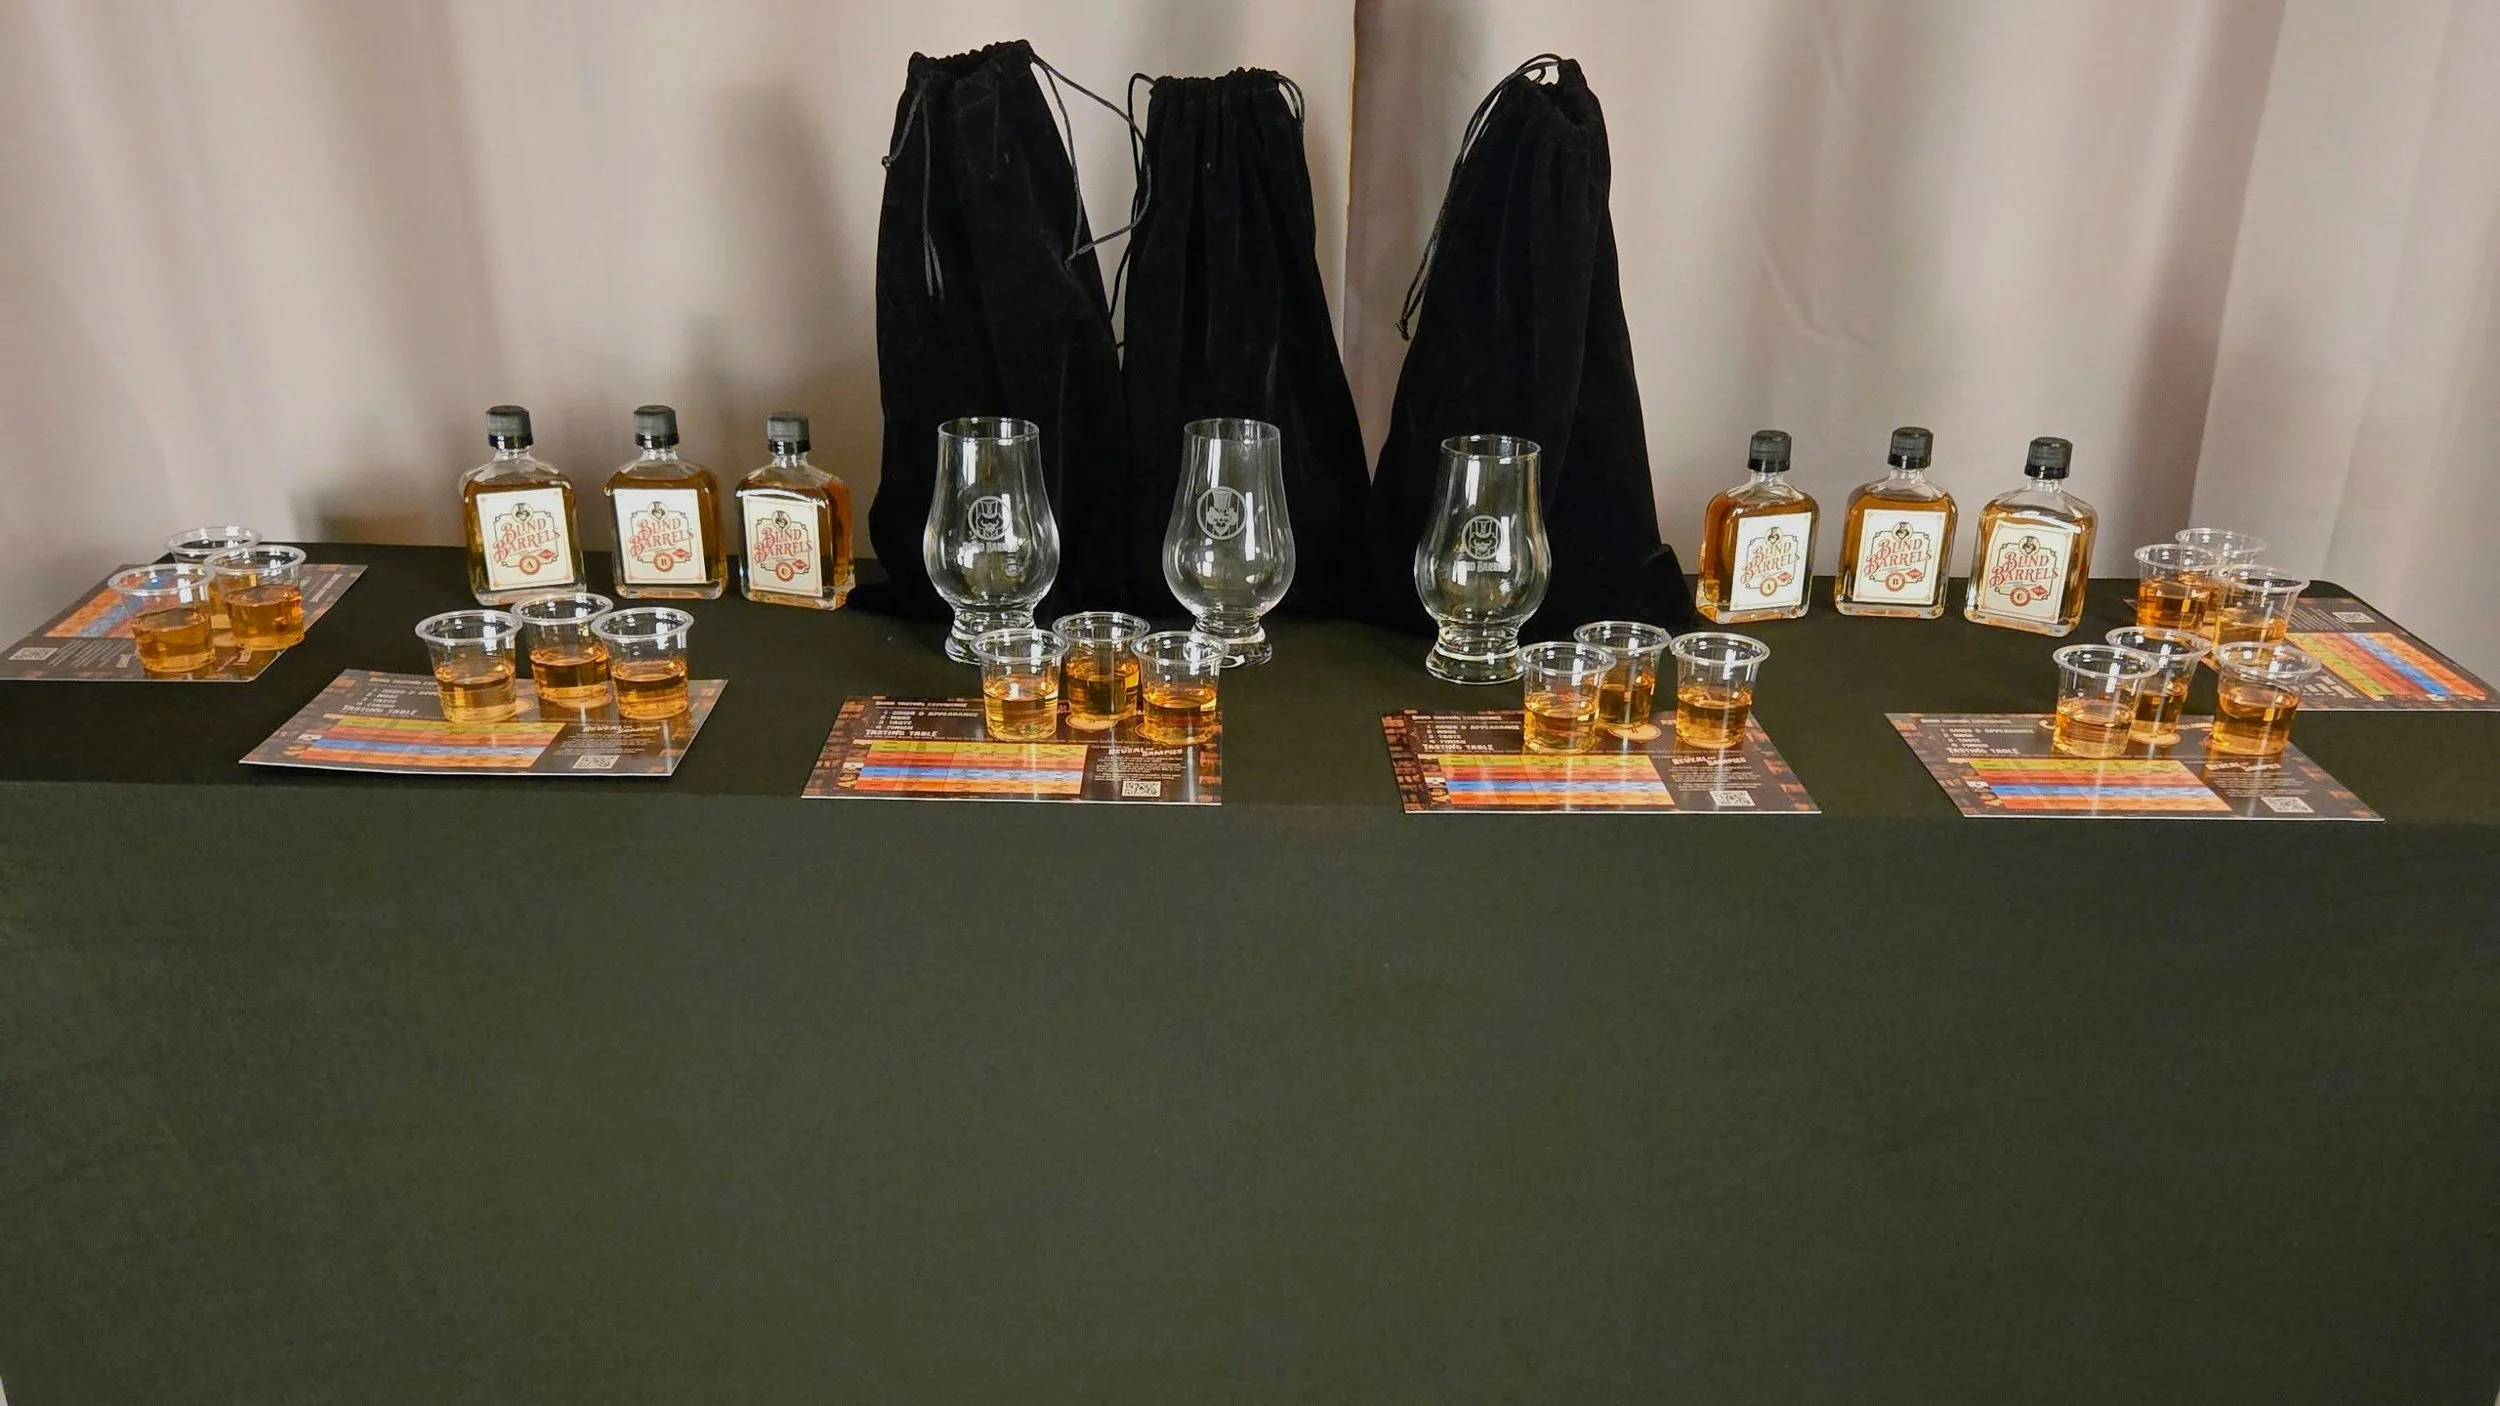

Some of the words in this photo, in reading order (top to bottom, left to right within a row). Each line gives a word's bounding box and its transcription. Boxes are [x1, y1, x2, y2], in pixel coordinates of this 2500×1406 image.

[501, 518, 546, 541] BLIND
[637, 518, 681, 539] BLIND
[762, 527, 802, 548] BLIND
[493, 528, 560, 563] BARRELS
[629, 528, 694, 558] BARRELS
[754, 541, 813, 564] BARRELS
[1752, 542, 1792, 564] BLIND
[1878, 539, 1922, 559] BLIND
[1741, 553, 1800, 584] BARRELS
[1864, 549, 1932, 577] BARRELS
[2005, 552, 2049, 572] BLIND
[1989, 567, 2059, 588] BARRELS
